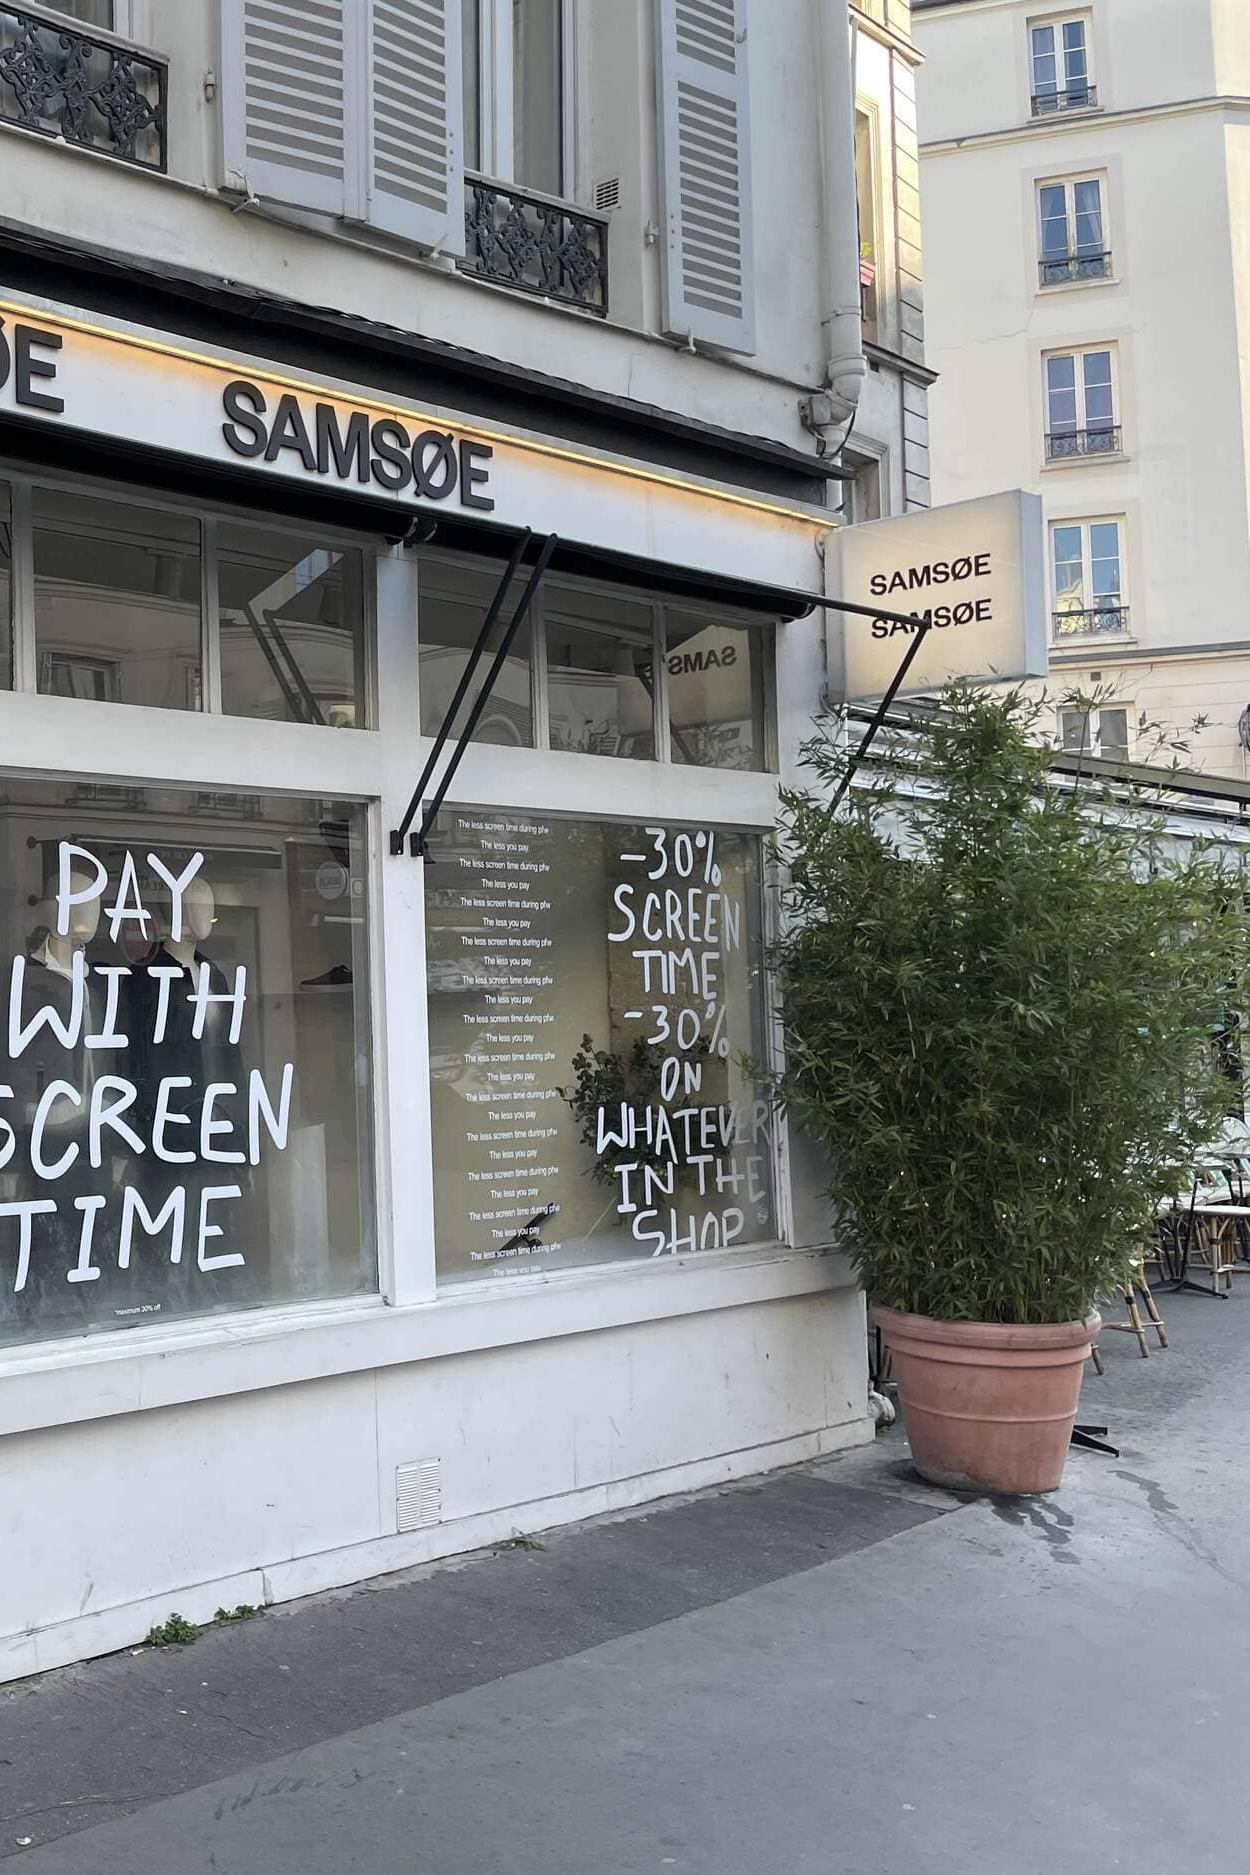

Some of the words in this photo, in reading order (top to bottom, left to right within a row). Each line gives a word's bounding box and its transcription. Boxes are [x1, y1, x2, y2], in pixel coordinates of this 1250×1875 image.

[222, 380, 494, 511] SAMSØE
[870, 553, 991, 595] SAMSØE
[458, 819, 470, 829] The
[471, 821, 483, 830] less
[484, 823, 504, 831] screen
[506, 823, 518, 832] time
[519, 824, 537, 834] during
[481, 840, 492, 849] The
[493, 841, 505, 850] less
[506, 843, 517, 851] you
[518, 843, 529, 853] pay
[620, 827, 722, 886] -30%
[459, 858, 471, 868] The
[472, 860, 484, 868] less
[485, 861, 505, 869] screen
[507, 862, 519, 870] time
[520, 862, 538, 872] during
[481, 878, 493, 888] The
[494, 879, 506, 888] less
[507, 881, 518, 890] you
[519, 882, 530, 891] pay
[56, 841, 204, 944] PAY
[460, 897, 472, 907] The
[473, 898, 485, 907] less
[486, 900, 506, 908] screen
[508, 900, 520, 908] time
[521, 900, 539, 910] during
[482, 917, 494, 926] The
[495, 918, 507, 927] less
[508, 919, 519, 929] you
[520, 920, 531, 929] pay
[607, 883, 740, 951] SCREEN
[461, 936, 473, 946] The
[474, 937, 486, 946] less
[488, 938, 507, 946] screen
[509, 938, 521, 946] time
[522, 938, 540, 948] during
[483, 956, 495, 965] The
[496, 956, 508, 965] less
[509, 958, 520, 967] you
[521, 958, 532, 967] pay
[462, 975, 474, 985] The
[475, 976, 487, 985] less
[489, 977, 508, 985] screen
[510, 976, 522, 985] time
[523, 976, 541, 986] during
[632, 947, 720, 1000] TIME
[8, 950, 247, 1058] WITH
[484, 995, 497, 1004] The
[497, 995, 509, 1004] less
[510, 996, 521, 1005] you
[522, 996, 533, 1005] pay
[463, 1015, 475, 1024] The
[476, 1015, 489, 1023] less
[511, 1015, 523, 1023] time
[524, 1014, 542, 1024] during
[624, 1001, 730, 1057] -30%
[485, 1033, 498, 1043] The
[498, 1033, 511, 1042] less
[512, 1034, 523, 1043] you
[523, 1034, 534, 1043] pay
[464, 1054, 476, 1063] The
[477, 1054, 490, 1062] less
[491, 1054, 510, 1062] screen
[512, 1053, 524, 1061] time
[525, 1053, 544, 1062] during
[661, 1056, 701, 1101] ON
[466, 1093, 478, 1102] The
[478, 1093, 491, 1102] less
[492, 1093, 512, 1101] screen
[513, 1092, 525, 1100] time
[527, 1091, 545, 1100] during
[467, 1133, 479, 1142] The
[480, 1132, 492, 1141] less
[493, 1132, 513, 1140] screen
[514, 1130, 527, 1139] time
[528, 1129, 546, 1138] during
[596, 1101, 773, 1164] WHATEVER
[489, 1151, 501, 1160] The
[502, 1150, 514, 1159] less
[515, 1150, 526, 1159] you
[526, 1149, 537, 1158] pay
[468, 1172, 480, 1181] The
[481, 1171, 493, 1180] less
[494, 1171, 514, 1179] screen
[515, 1169, 528, 1177] time
[529, 1167, 547, 1176] during
[614, 1161, 673, 1213] IN
[686, 1154, 765, 1204] THE
[490, 1190, 502, 1199] The
[503, 1189, 515, 1198] less
[516, 1189, 527, 1198] you
[528, 1188, 539, 1197] pay
[469, 1212, 481, 1221] The
[482, 1211, 495, 1220] less
[495, 1209, 516, 1218] screen
[517, 1208, 529, 1216] time
[530, 1206, 548, 1215] during
[491, 1229, 503, 1238] The
[504, 1228, 516, 1237] less
[517, 1227, 528, 1237] you
[529, 1226, 540, 1235] pay
[632, 1207, 745, 1257] SHOP
[470, 1252, 482, 1261] The
[483, 1251, 496, 1259] less
[497, 1248, 517, 1258] screen
[518, 1247, 530, 1255] time
[531, 1245, 549, 1254] during
